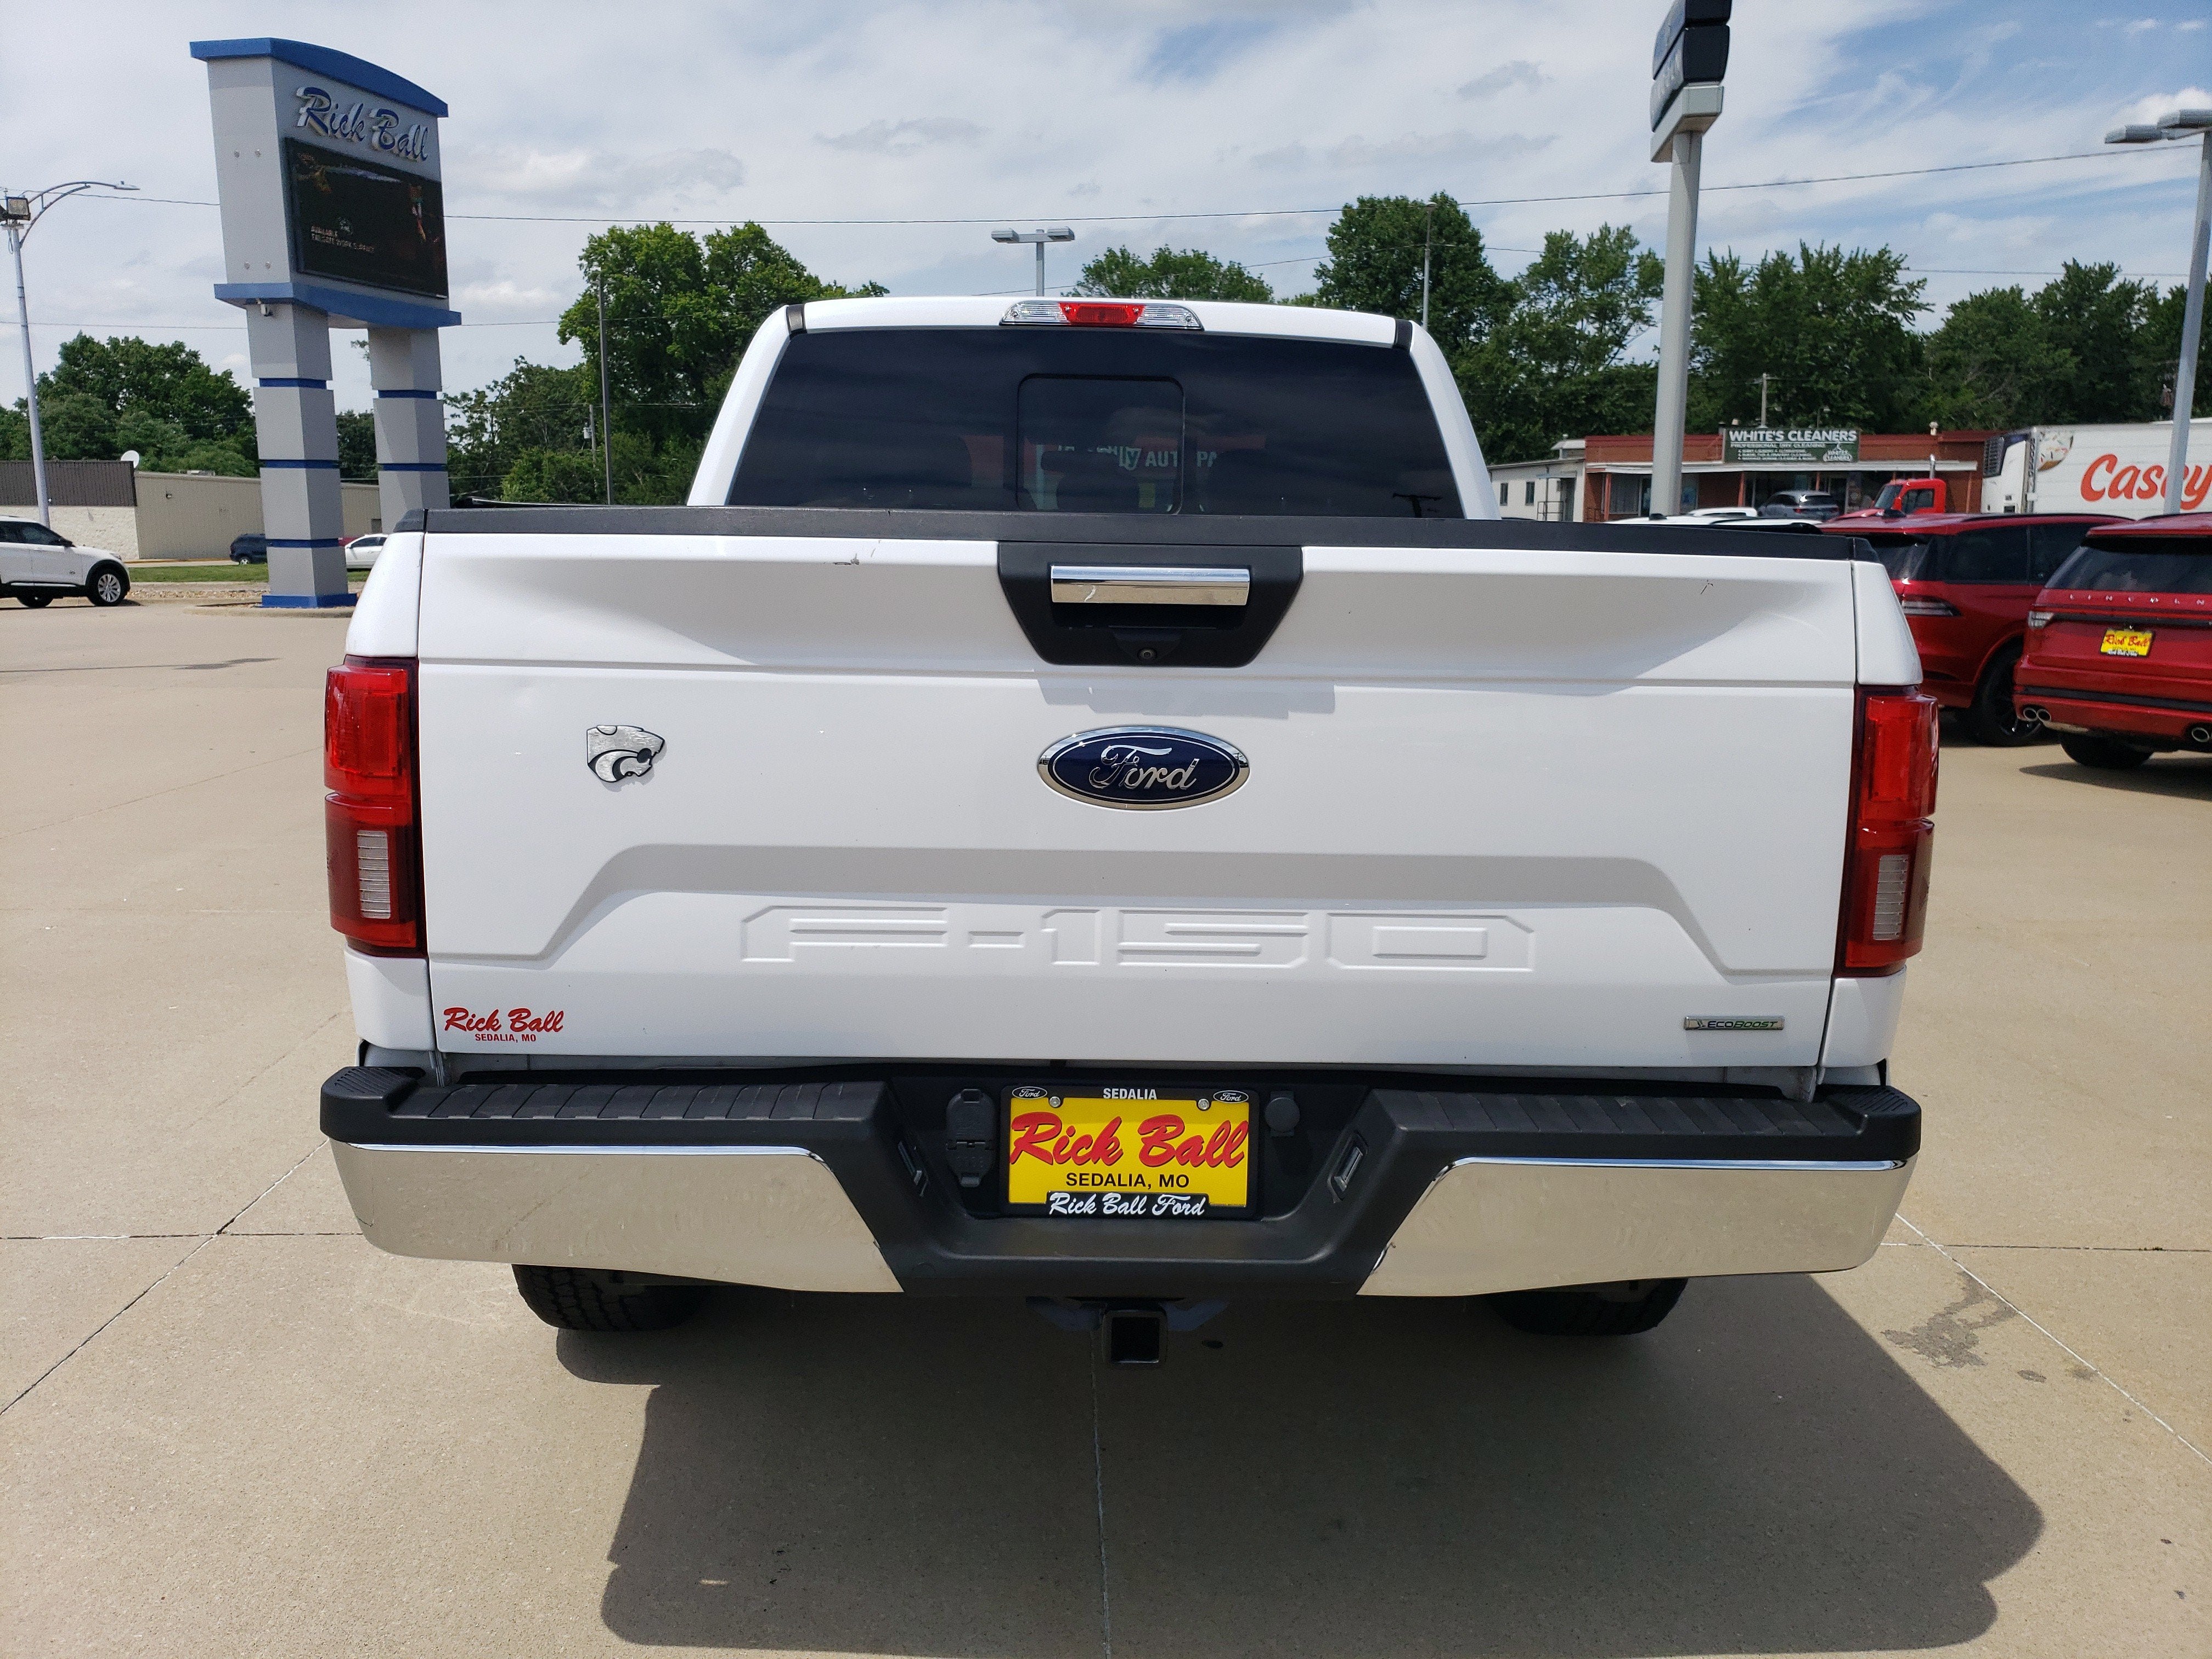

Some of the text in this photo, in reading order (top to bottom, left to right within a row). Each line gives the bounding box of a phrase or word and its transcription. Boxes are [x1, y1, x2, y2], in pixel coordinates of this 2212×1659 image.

[296, 87, 429, 162] Rick Ball
[1729, 430, 1857, 442] WHITE'S CLEANERS
[2080, 454, 2212, 510] Casy
[1088, 744, 1200, 789] Ford
[741, 905, 1534, 972] F-150
[443, 1007, 564, 1032] Rick Ball
[475, 1034, 537, 1043] SEDALIA, MO
[1018, 1088, 1041, 1098] Ford
[1103, 1088, 1158, 1100] SEDALIA
[1219, 1092, 1242, 1102] Ford
[1010, 1111, 1249, 1169] Rick Ball
[1065, 1172, 1190, 1189] SEDALIA, MO
[1049, 1192, 1205, 1216] Rick Ball Ford
